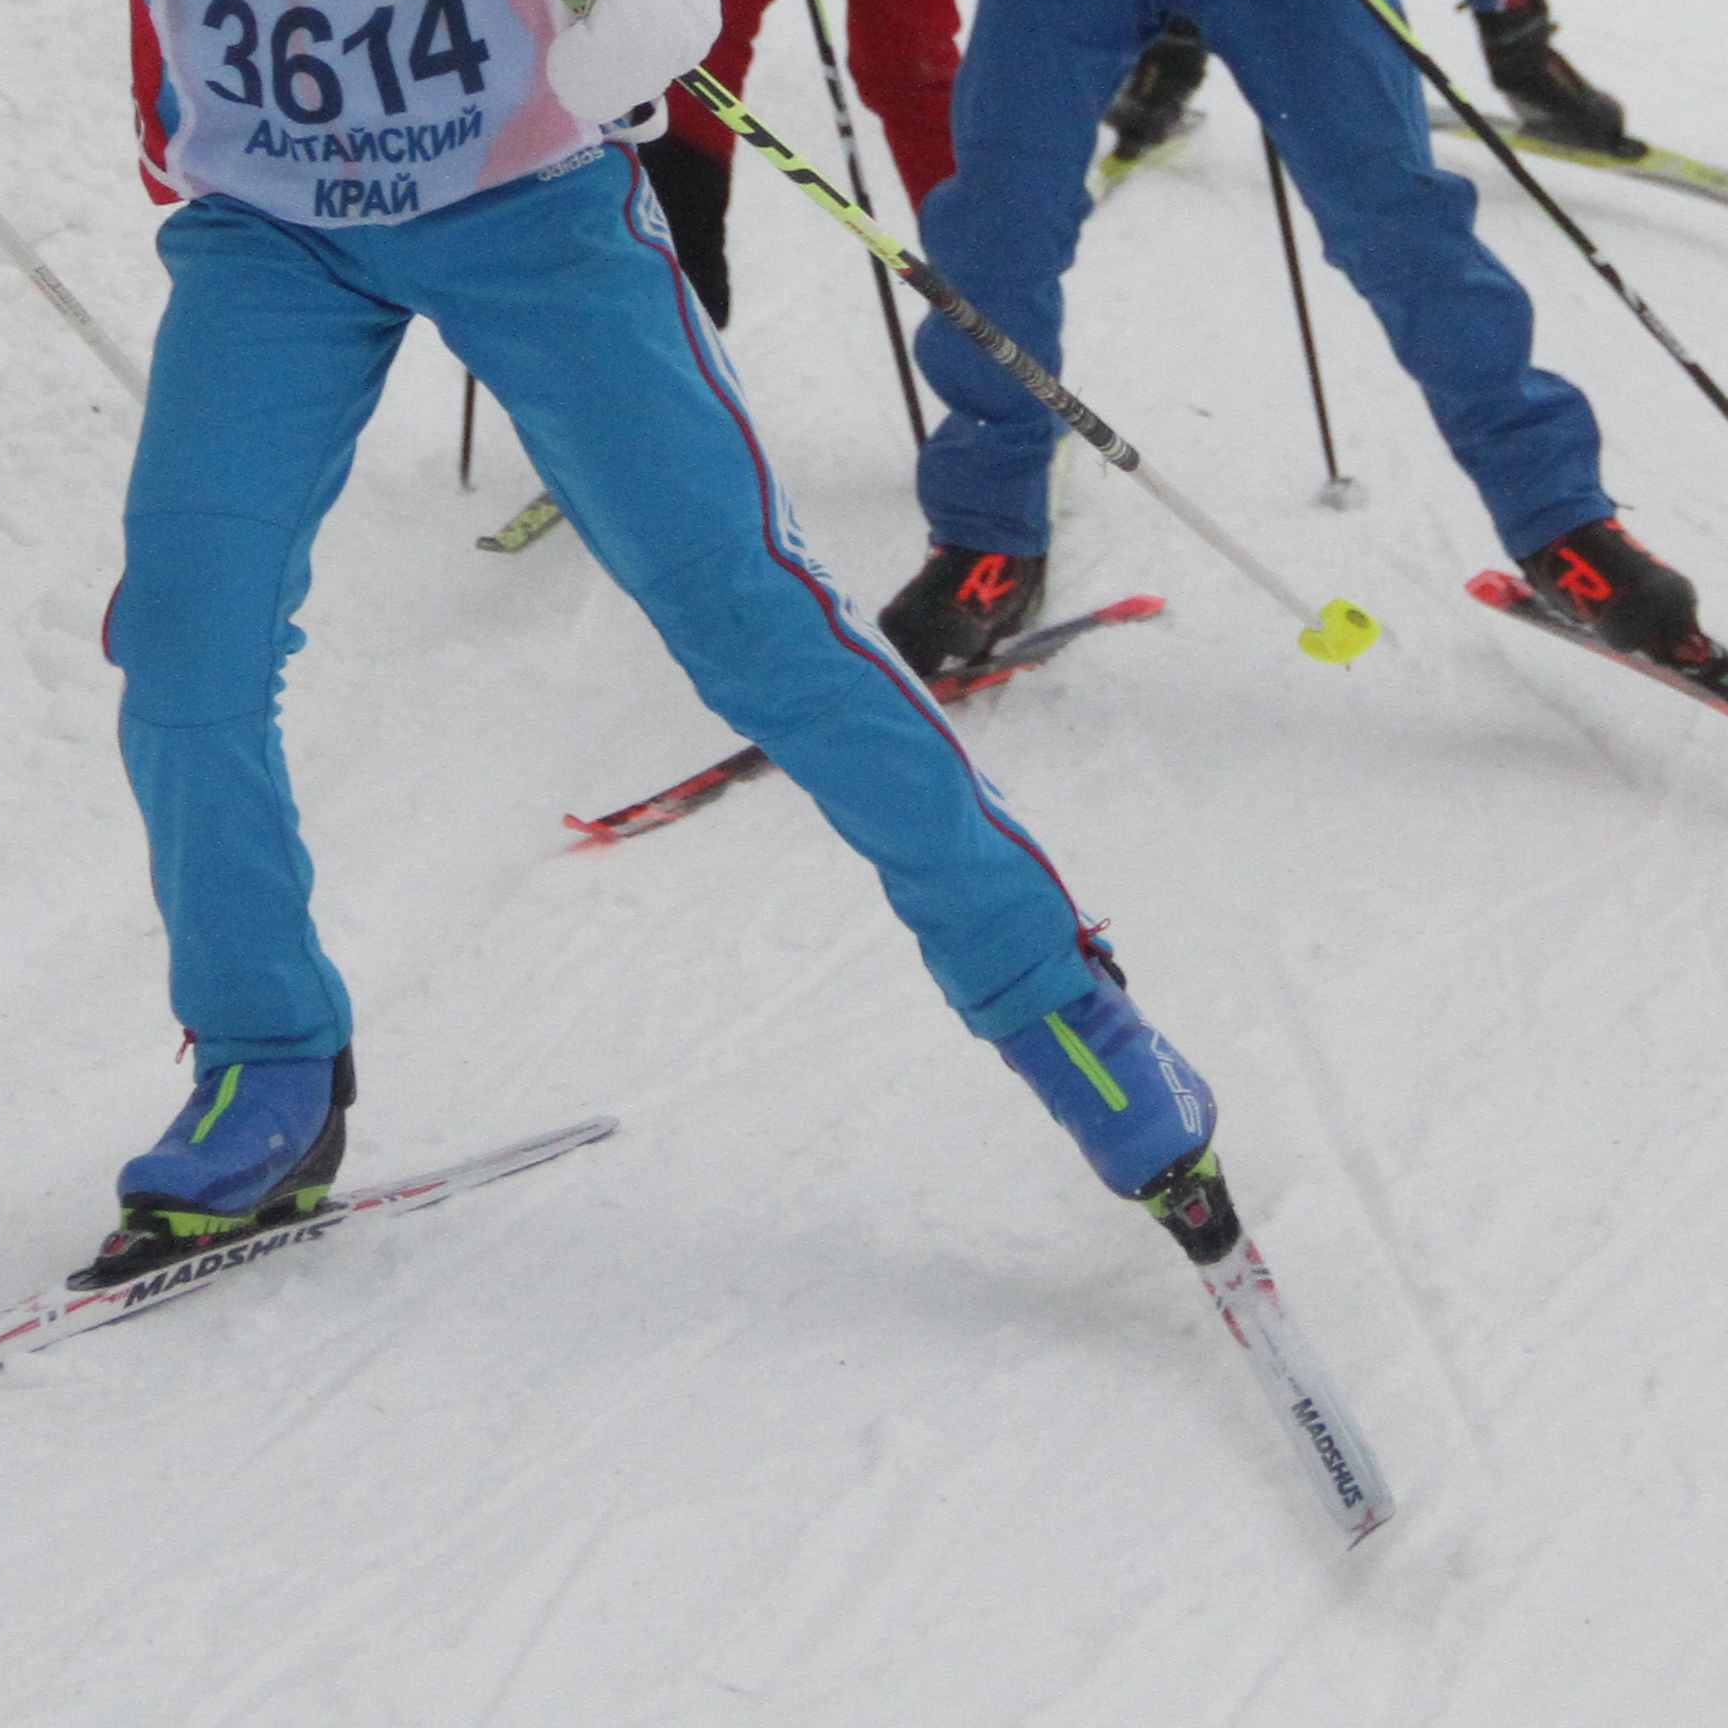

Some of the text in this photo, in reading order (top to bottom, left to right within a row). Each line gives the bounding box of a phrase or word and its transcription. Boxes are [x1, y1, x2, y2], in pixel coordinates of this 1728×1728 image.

[244, 104, 483, 164] АЛТАЙСКИЙ
[314, 172, 420, 218] КРАЙ
[1292, 1397, 1363, 1509] MADSHUS
